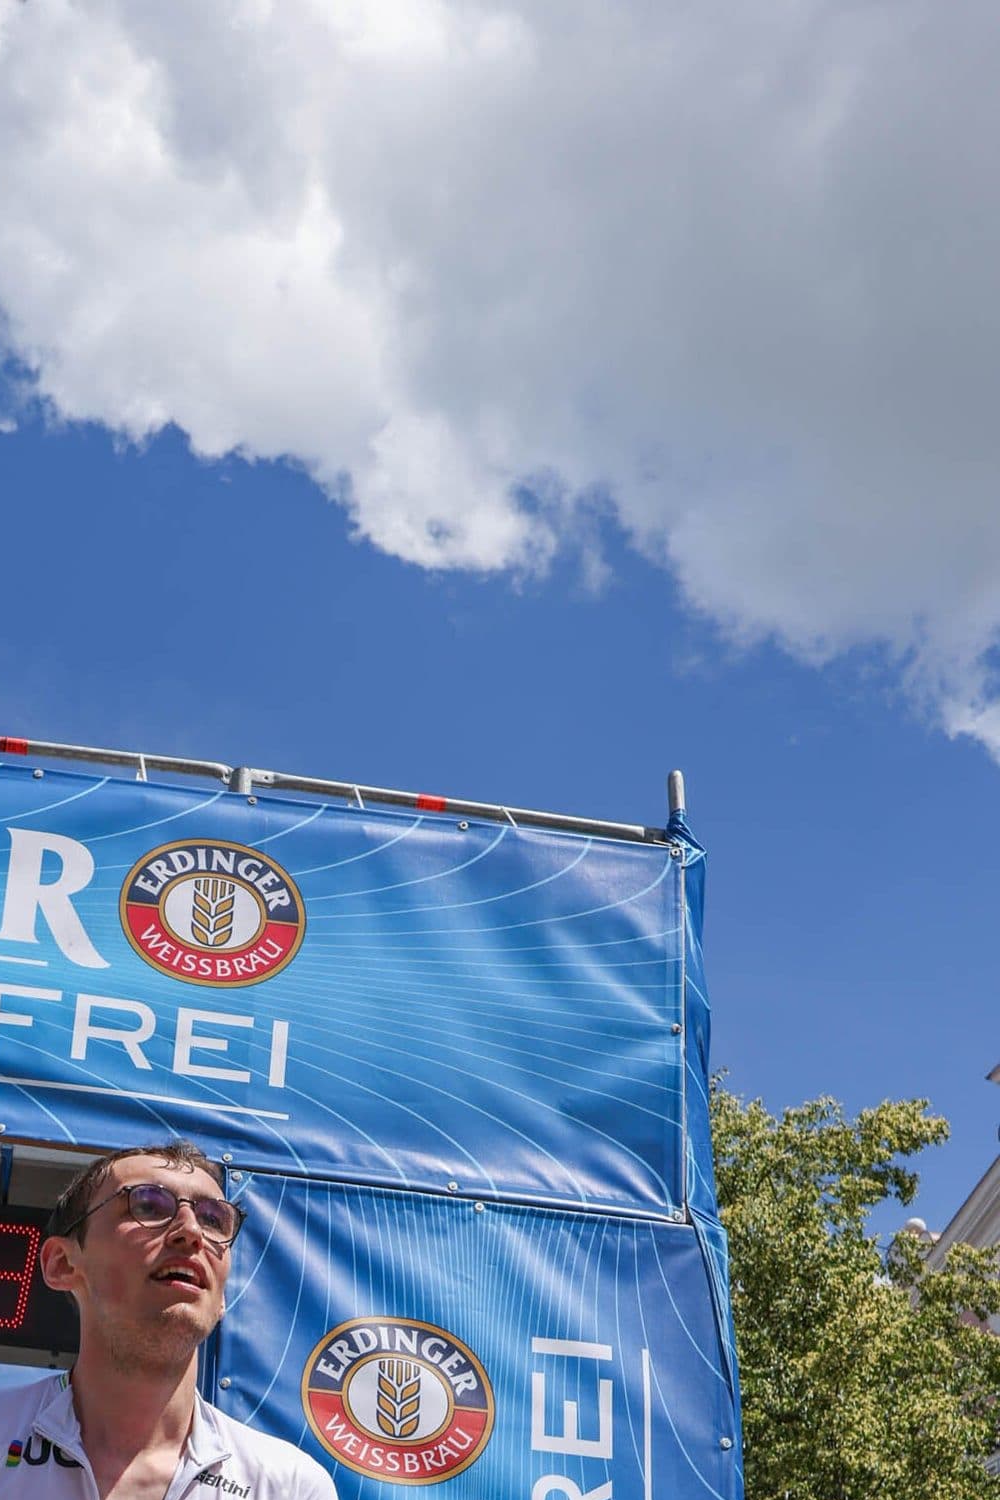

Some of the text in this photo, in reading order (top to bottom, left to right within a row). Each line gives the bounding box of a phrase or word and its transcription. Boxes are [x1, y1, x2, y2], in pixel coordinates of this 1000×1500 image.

[136, 849, 292, 914] ERDINGER
[139, 924, 284, 978] WEISSBRÄU
[316, 1325, 482, 1397] ERDINGER
[325, 1411, 475, 1473] WEISSBRÄU
